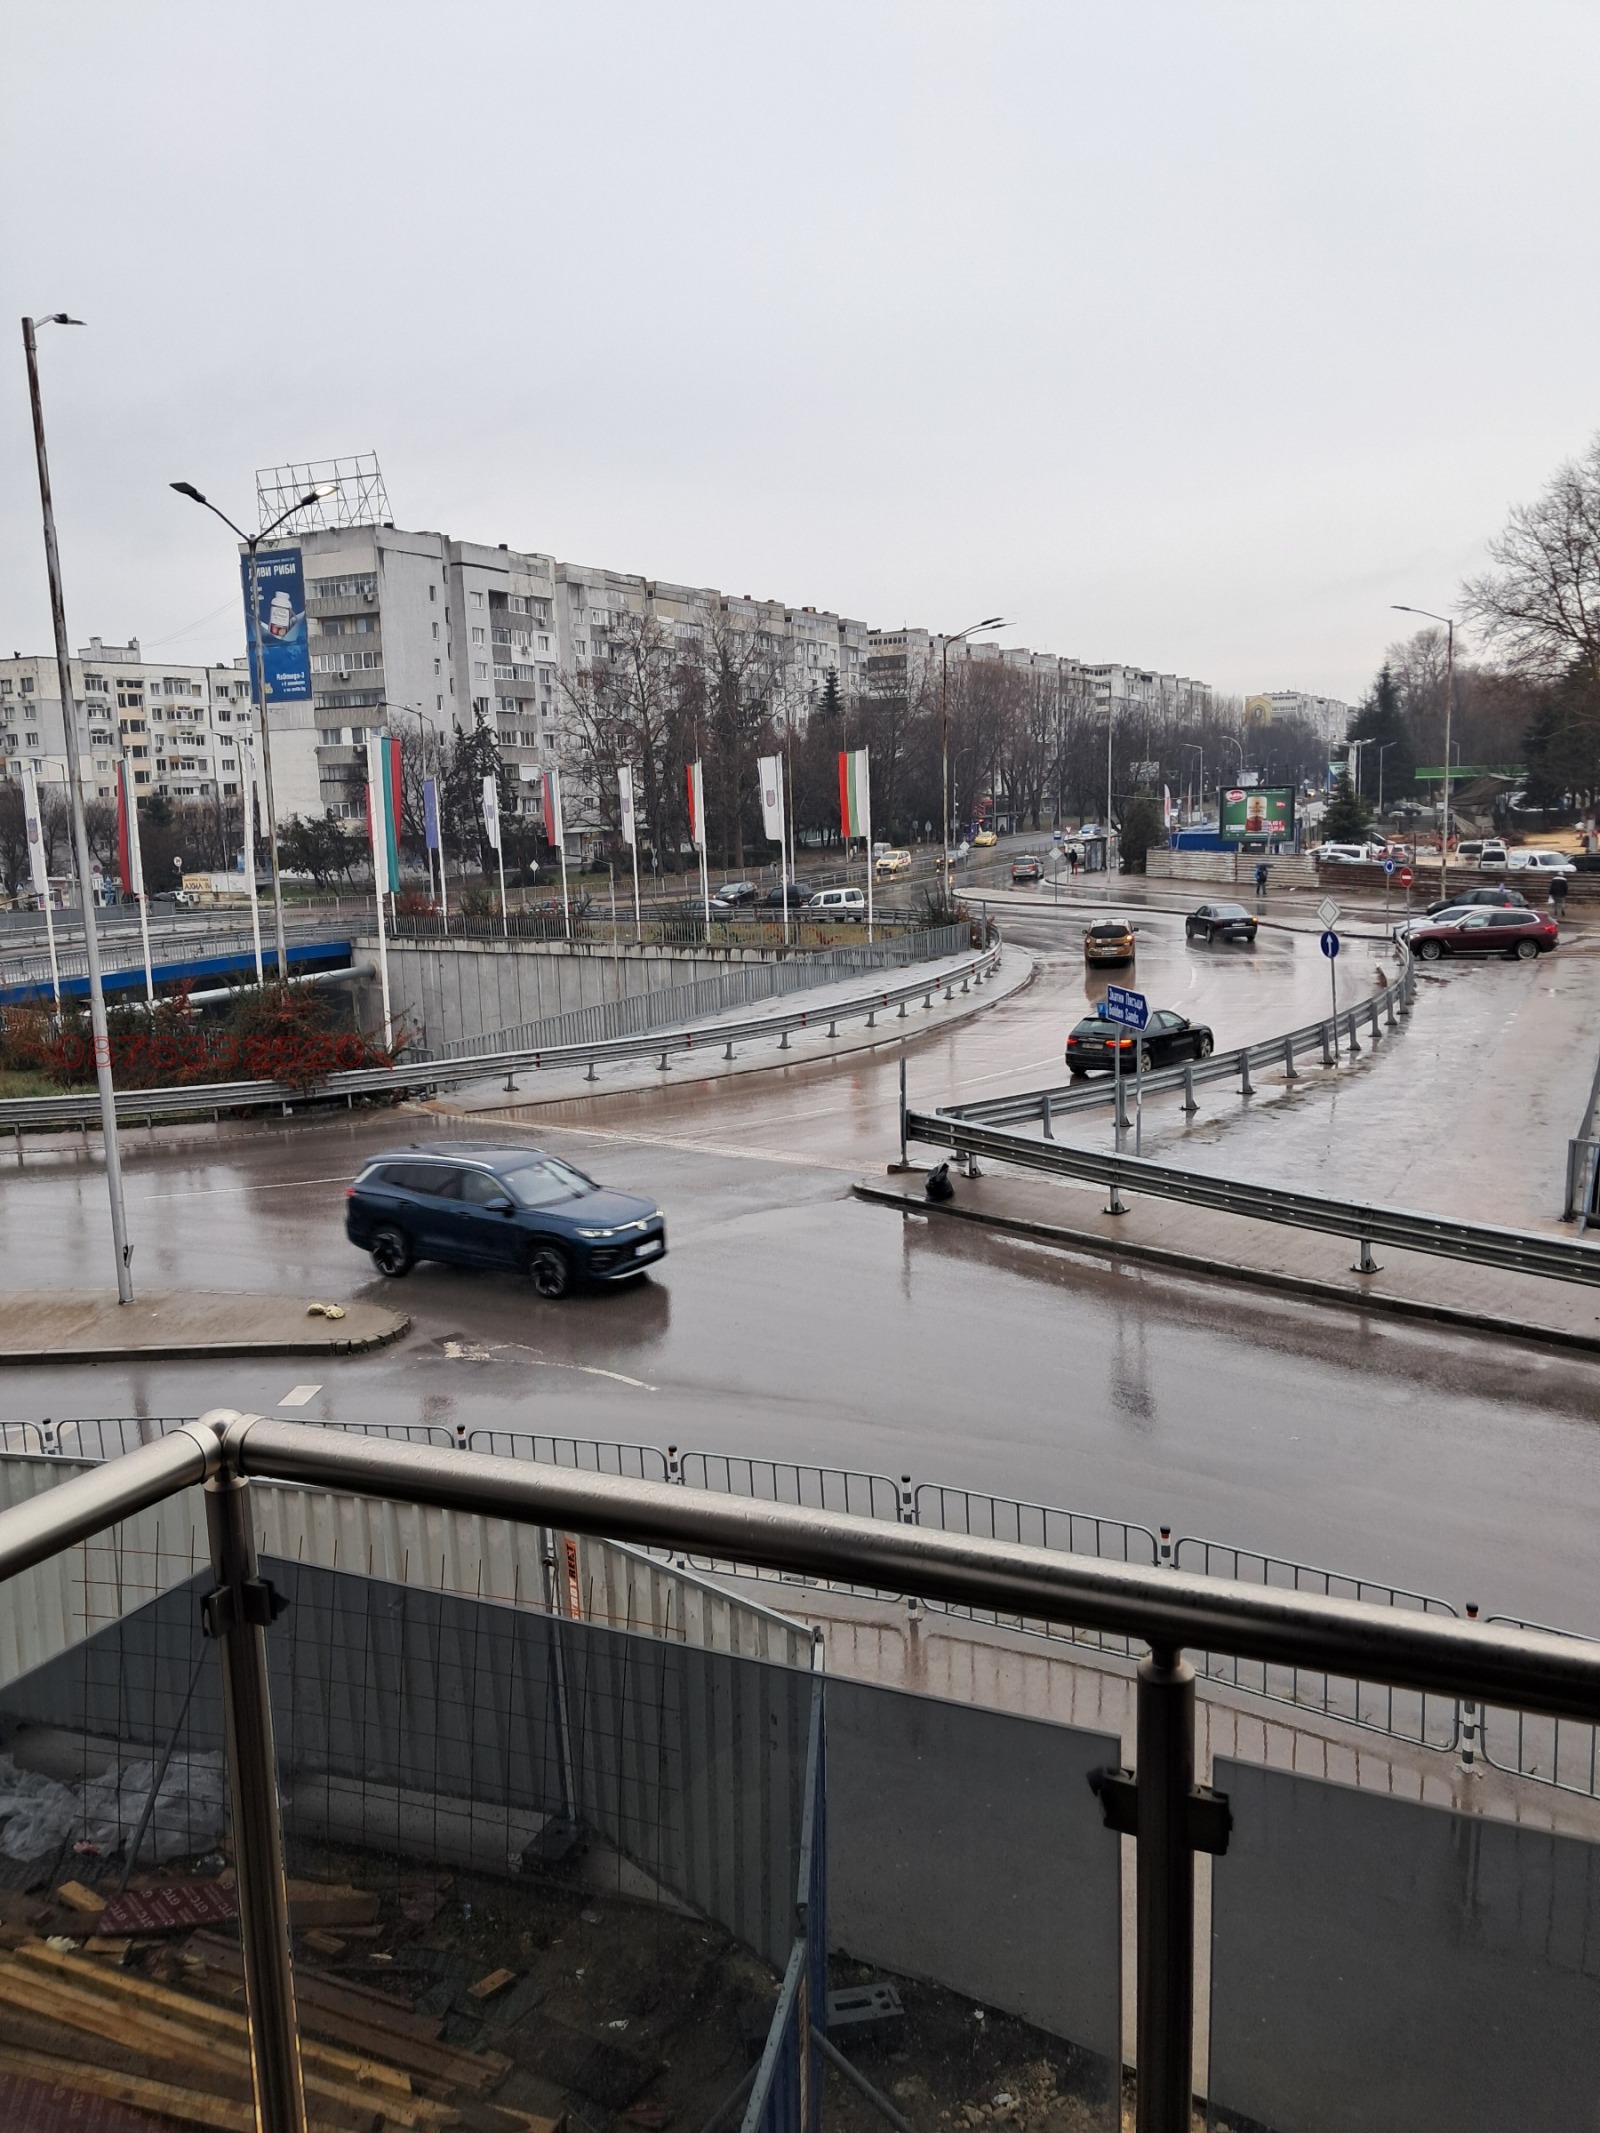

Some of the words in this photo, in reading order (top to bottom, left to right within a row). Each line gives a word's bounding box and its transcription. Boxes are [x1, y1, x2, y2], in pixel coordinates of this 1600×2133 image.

[273, 563, 296, 576] РИБИ
[1108, 1002, 1124, 1019] Golden
[1125, 1007, 1139, 1025] Sands
[162, 1888, 181, 1906] GTC
[190, 1895, 209, 1913] GTC
[109, 1903, 128, 1921] GTC
